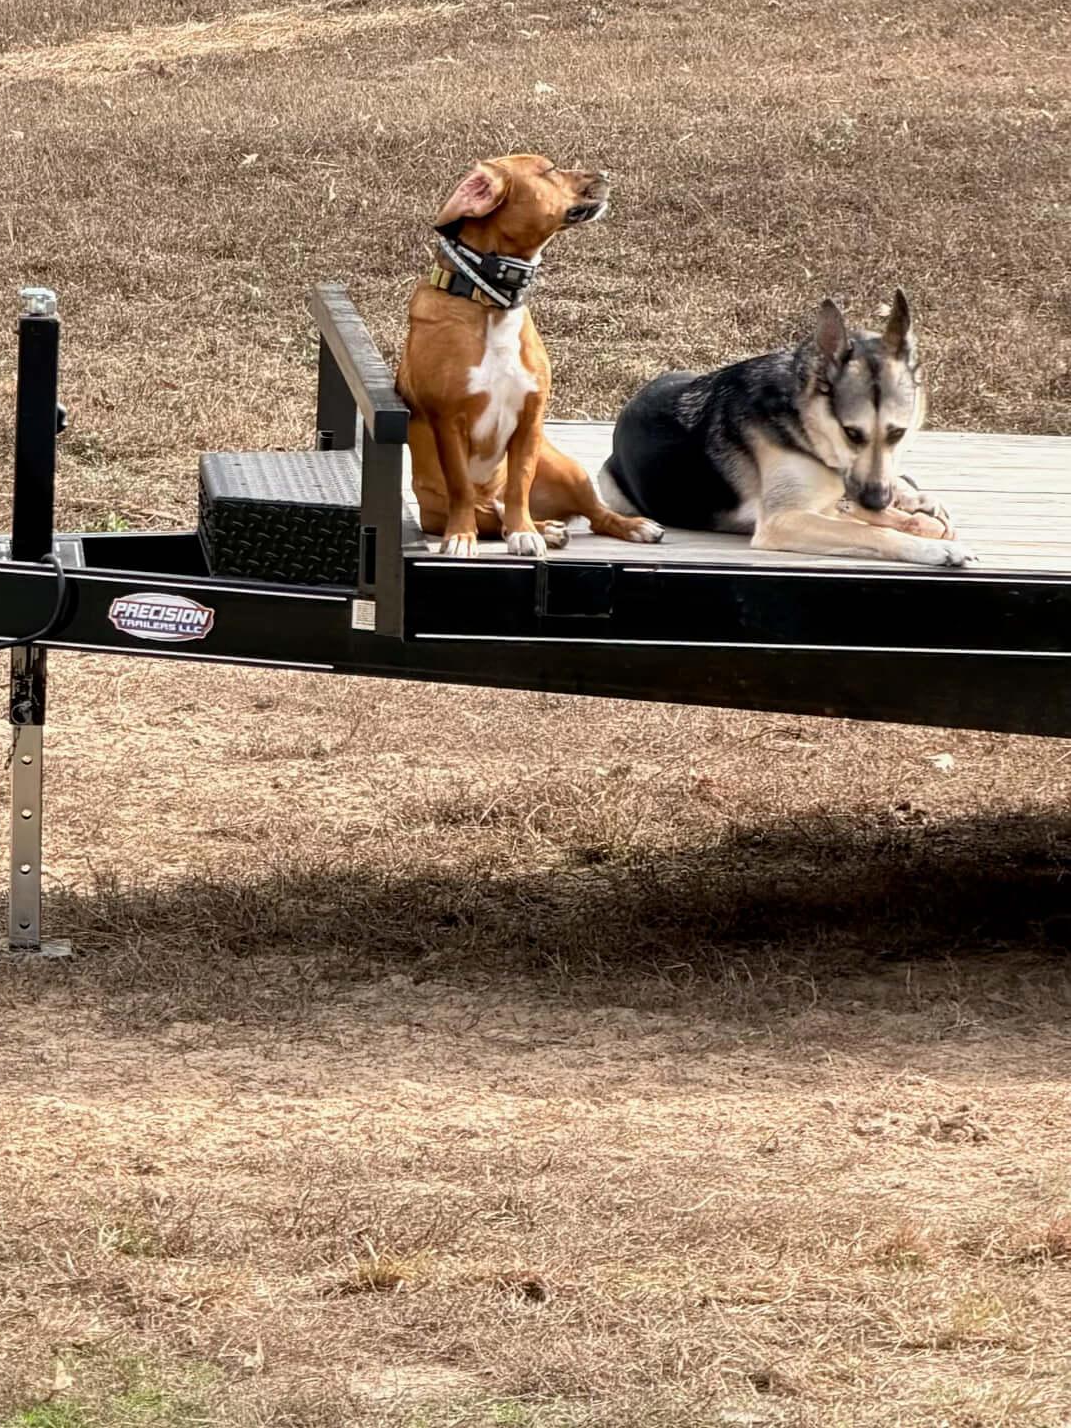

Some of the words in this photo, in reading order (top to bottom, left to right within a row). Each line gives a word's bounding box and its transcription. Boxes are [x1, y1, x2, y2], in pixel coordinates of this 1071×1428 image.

[113, 602, 209, 625] PRECISION
[120, 618, 177, 632] TRAILERS
[179, 624, 204, 634] LLC
